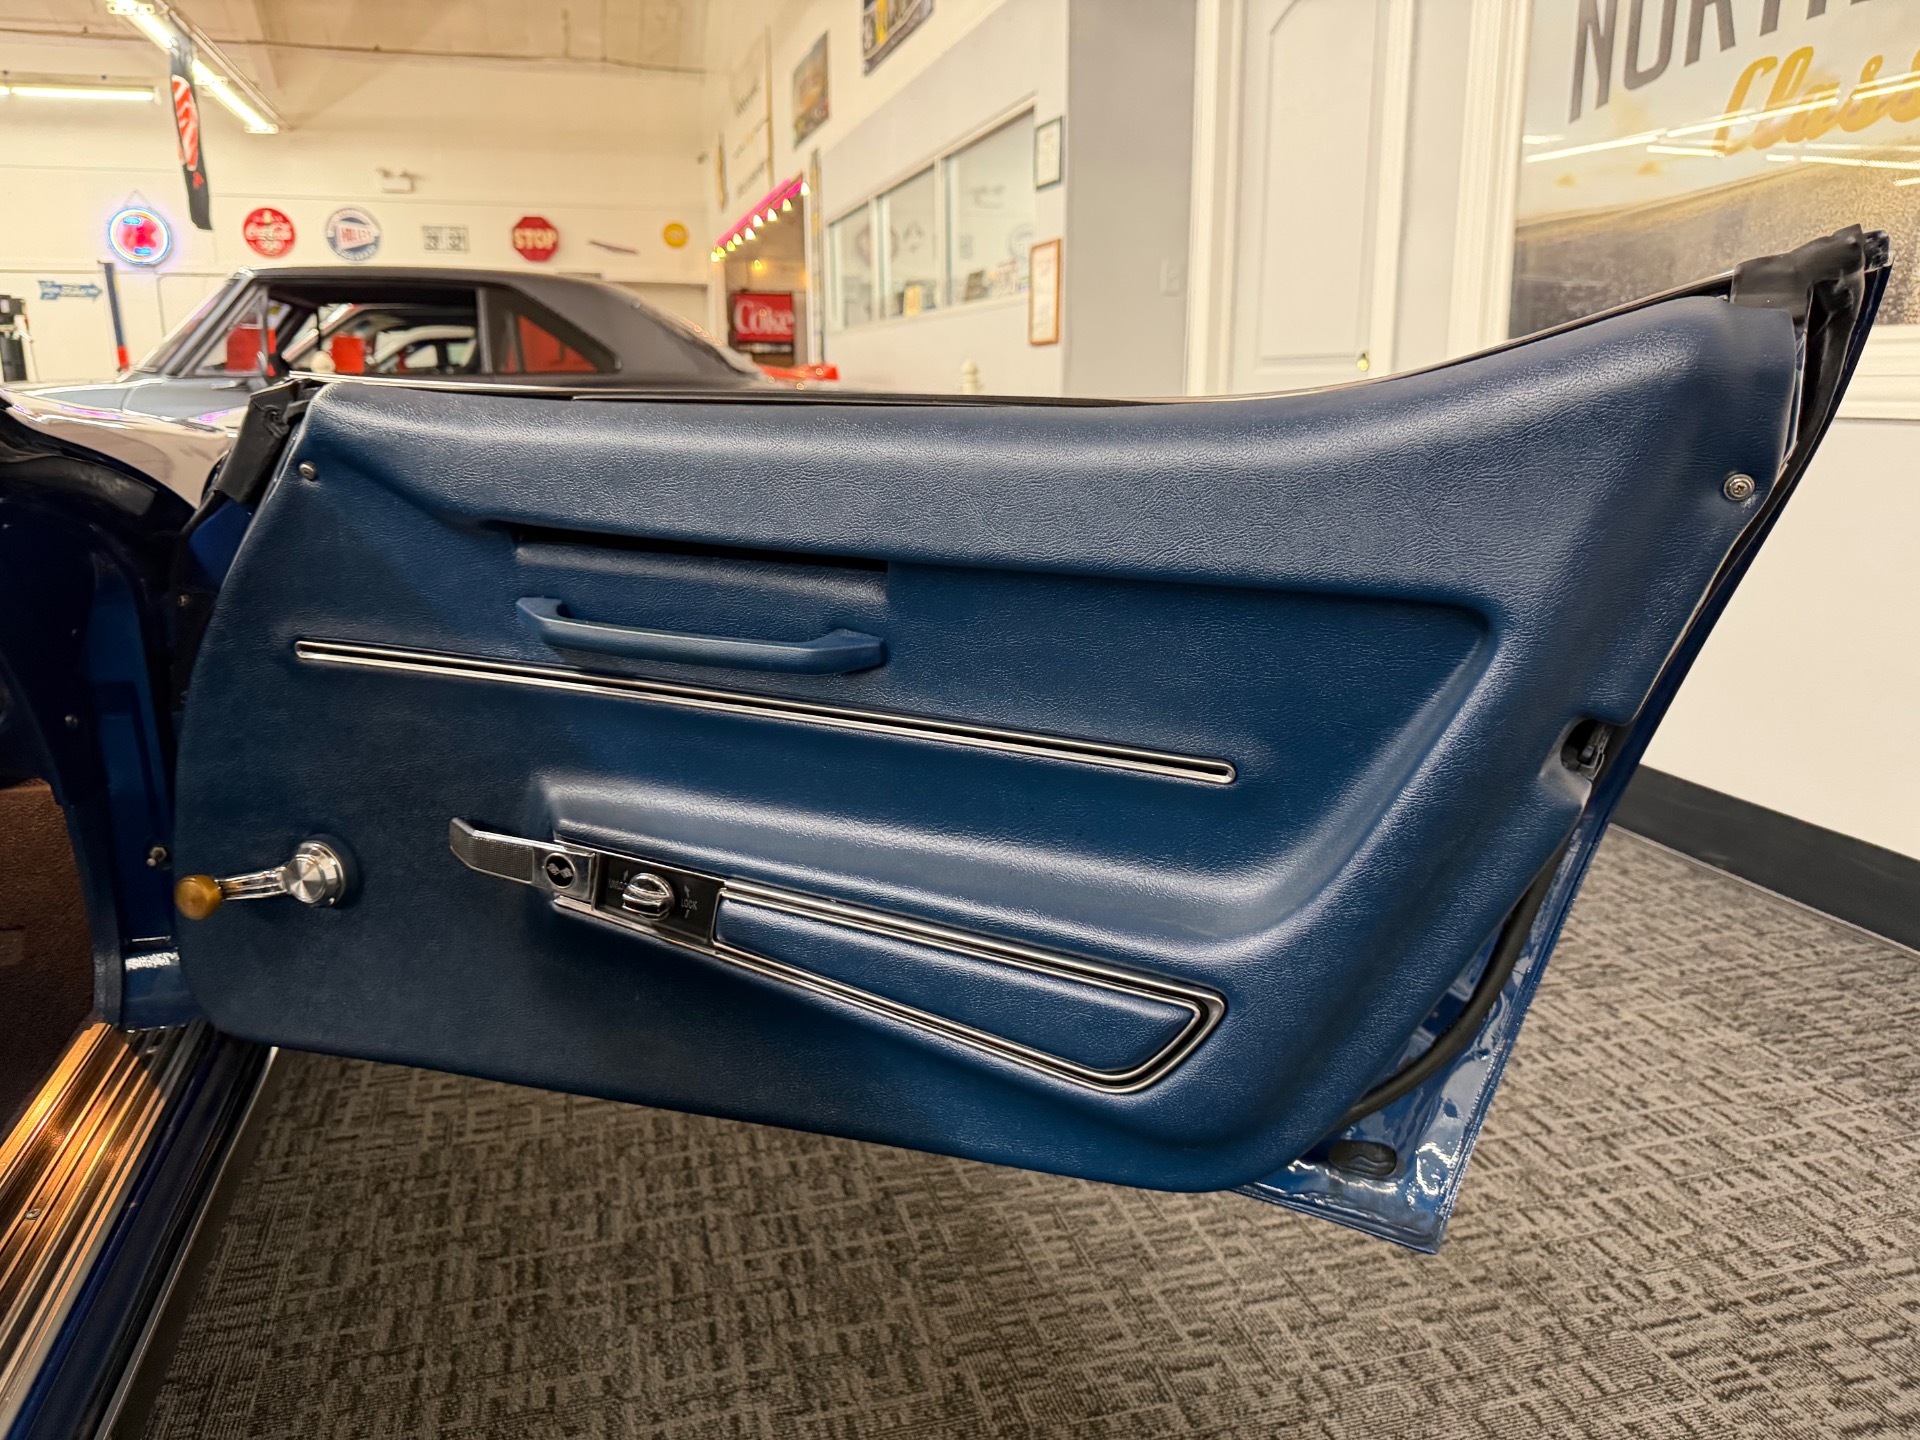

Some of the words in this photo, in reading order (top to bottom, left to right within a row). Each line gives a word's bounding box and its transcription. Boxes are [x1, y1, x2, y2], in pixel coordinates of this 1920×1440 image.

[514, 227, 558, 250] STOP
[734, 299, 794, 335] Coke
[680, 898, 698, 911] LOCK
